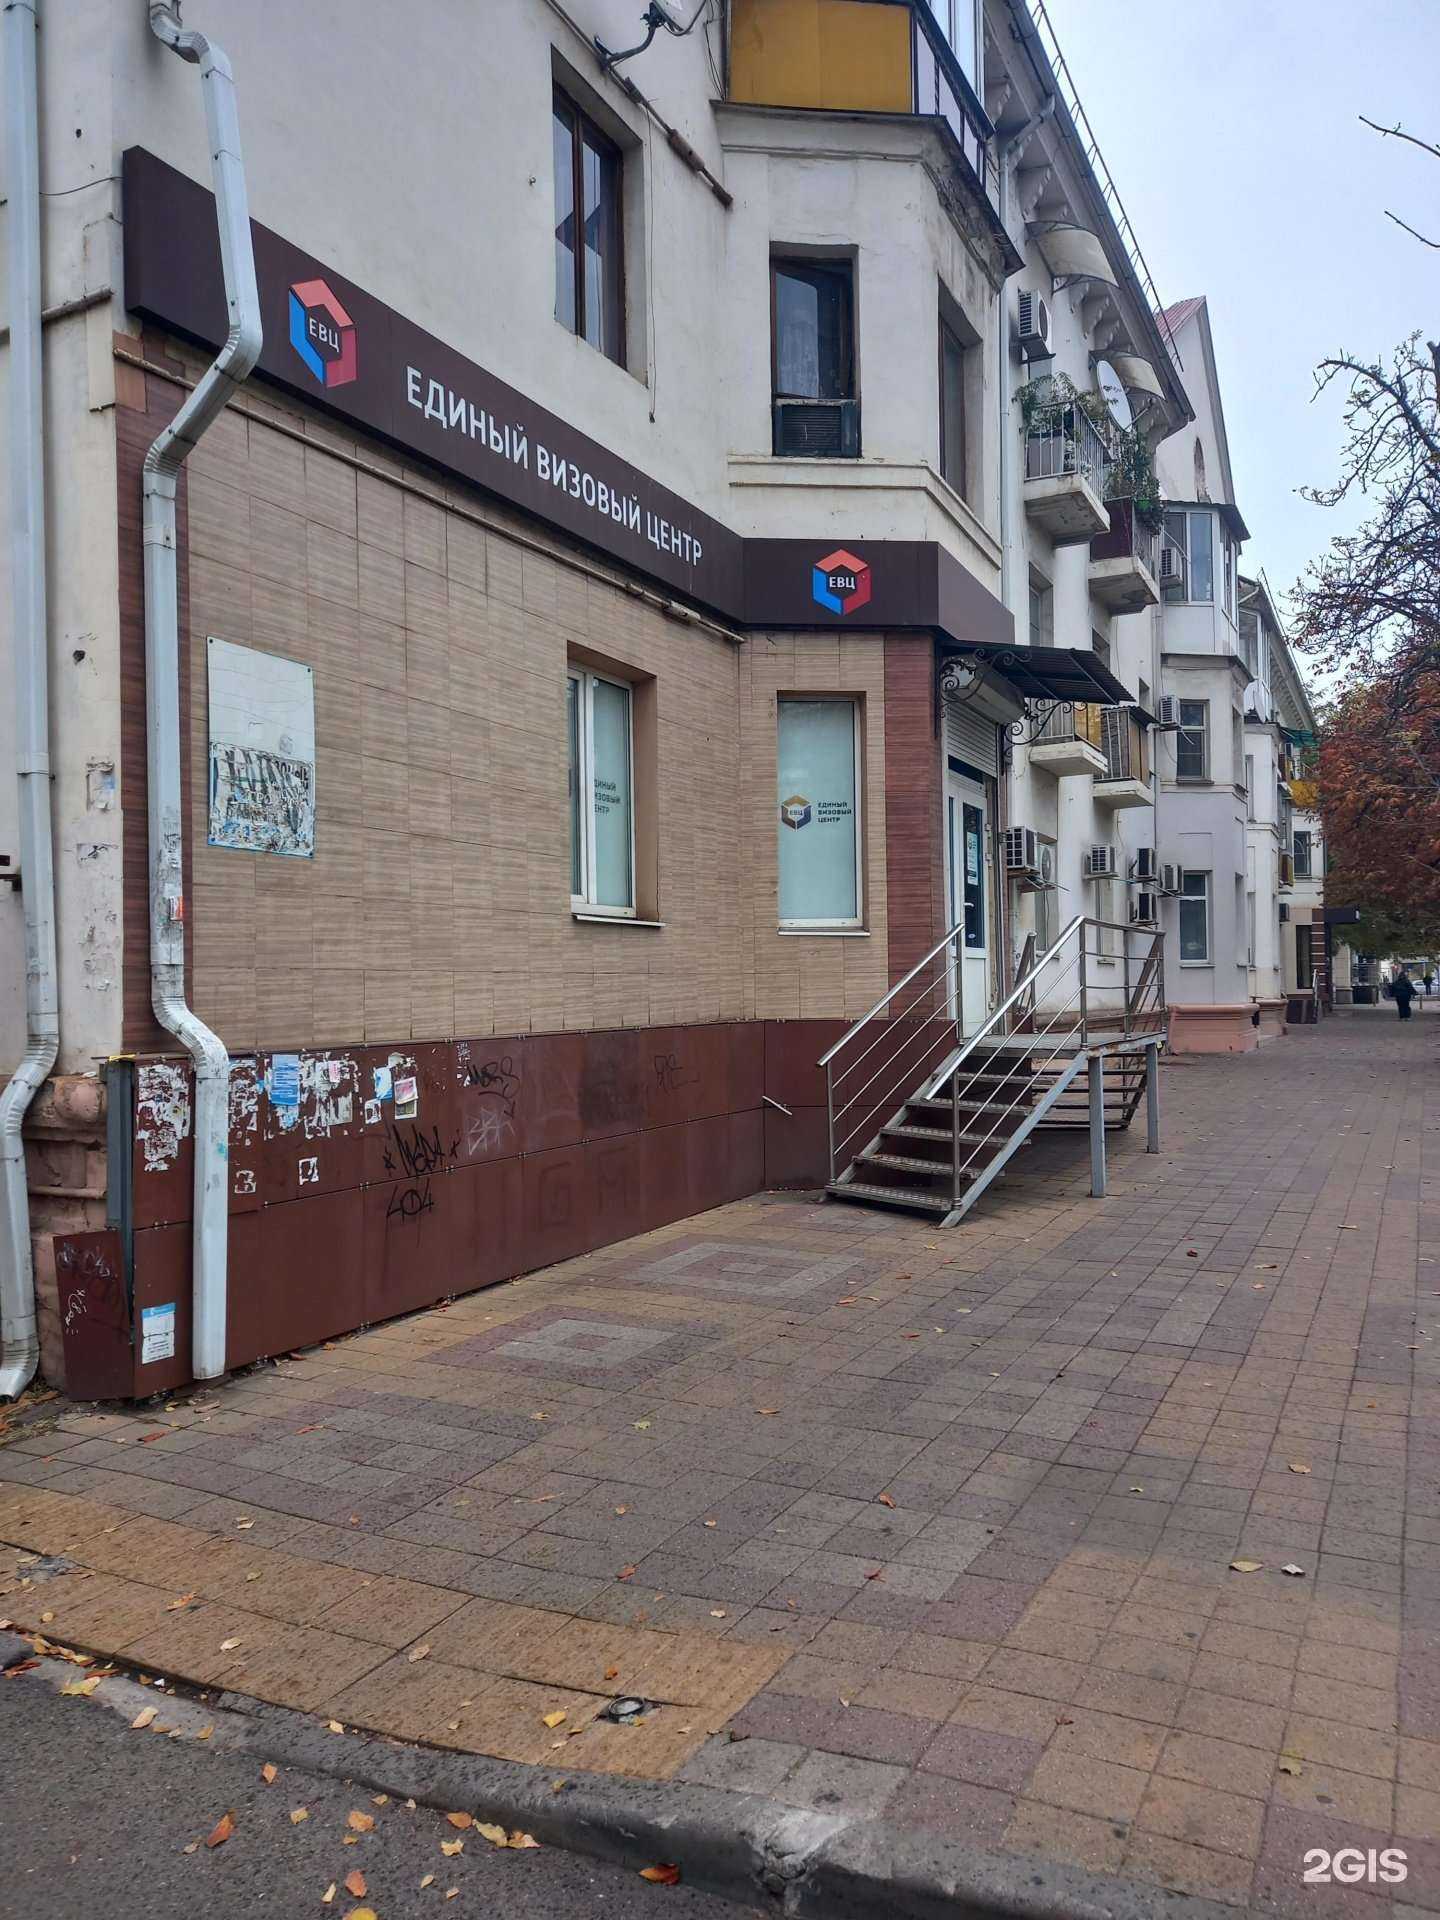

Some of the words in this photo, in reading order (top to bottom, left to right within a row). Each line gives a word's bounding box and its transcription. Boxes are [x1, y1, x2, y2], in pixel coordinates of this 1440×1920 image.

[309, 317, 340, 353] ЕВЦ
[407, 366, 529, 470] ЕДИНЫЙ
[536, 443, 641, 534] ВИЗОВЫЙ
[647, 511, 703, 566] ЦЕНТР
[829, 576, 856, 590] ЕВЦ
[817, 801, 848, 809] ЕДИНЫЙ
[817, 808, 852, 816] ВИЗОВЫЙ
[817, 816, 841, 824] ЦЕНТР
